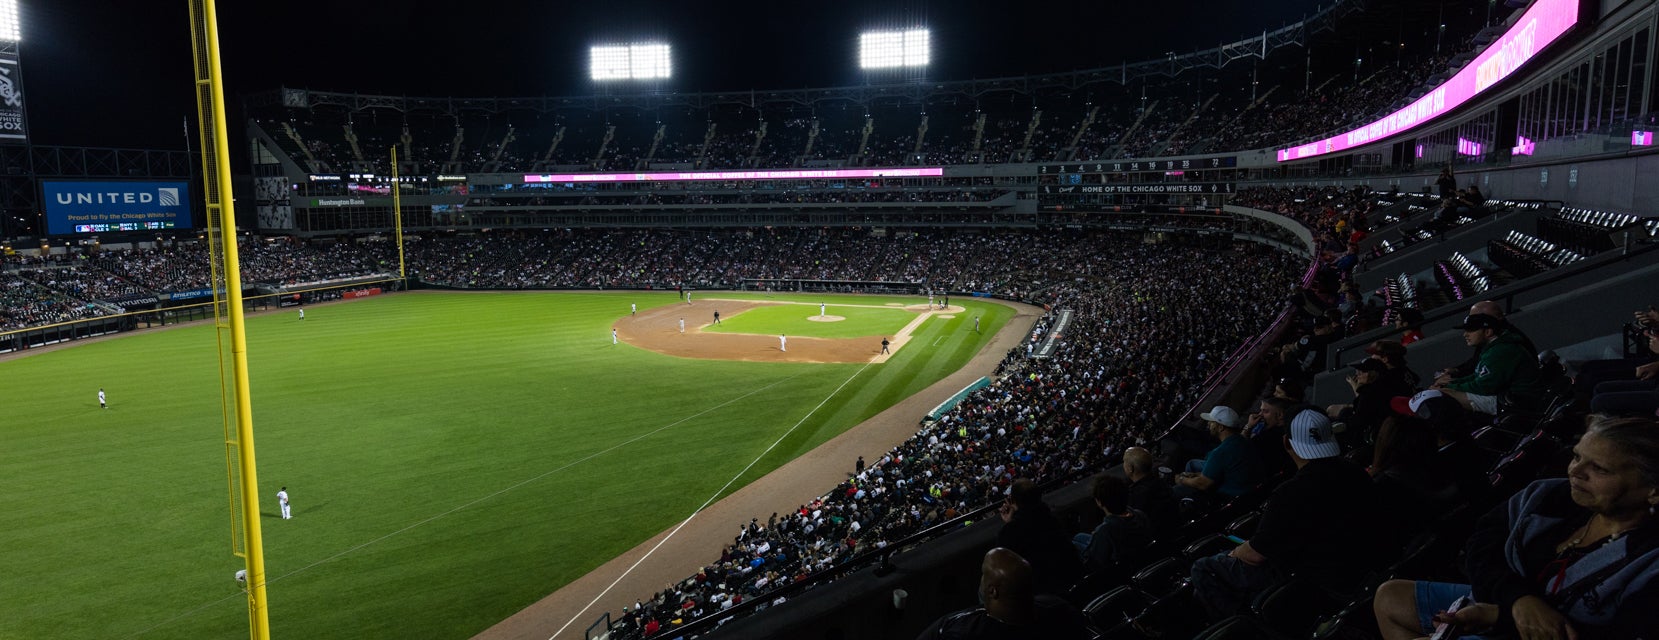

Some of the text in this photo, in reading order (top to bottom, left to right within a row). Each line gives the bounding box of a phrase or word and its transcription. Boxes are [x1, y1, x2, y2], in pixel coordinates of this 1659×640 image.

[1132, 185, 1165, 193] CHICAGO
[56, 192, 153, 205] UNITED
[319, 198, 365, 207] Huntington Bank
[99, 213, 109, 221] fly
[122, 212, 147, 220] Chicago
[173, 290, 201, 299] ATHLETICO
[118, 297, 158, 306] HYUNDAI
